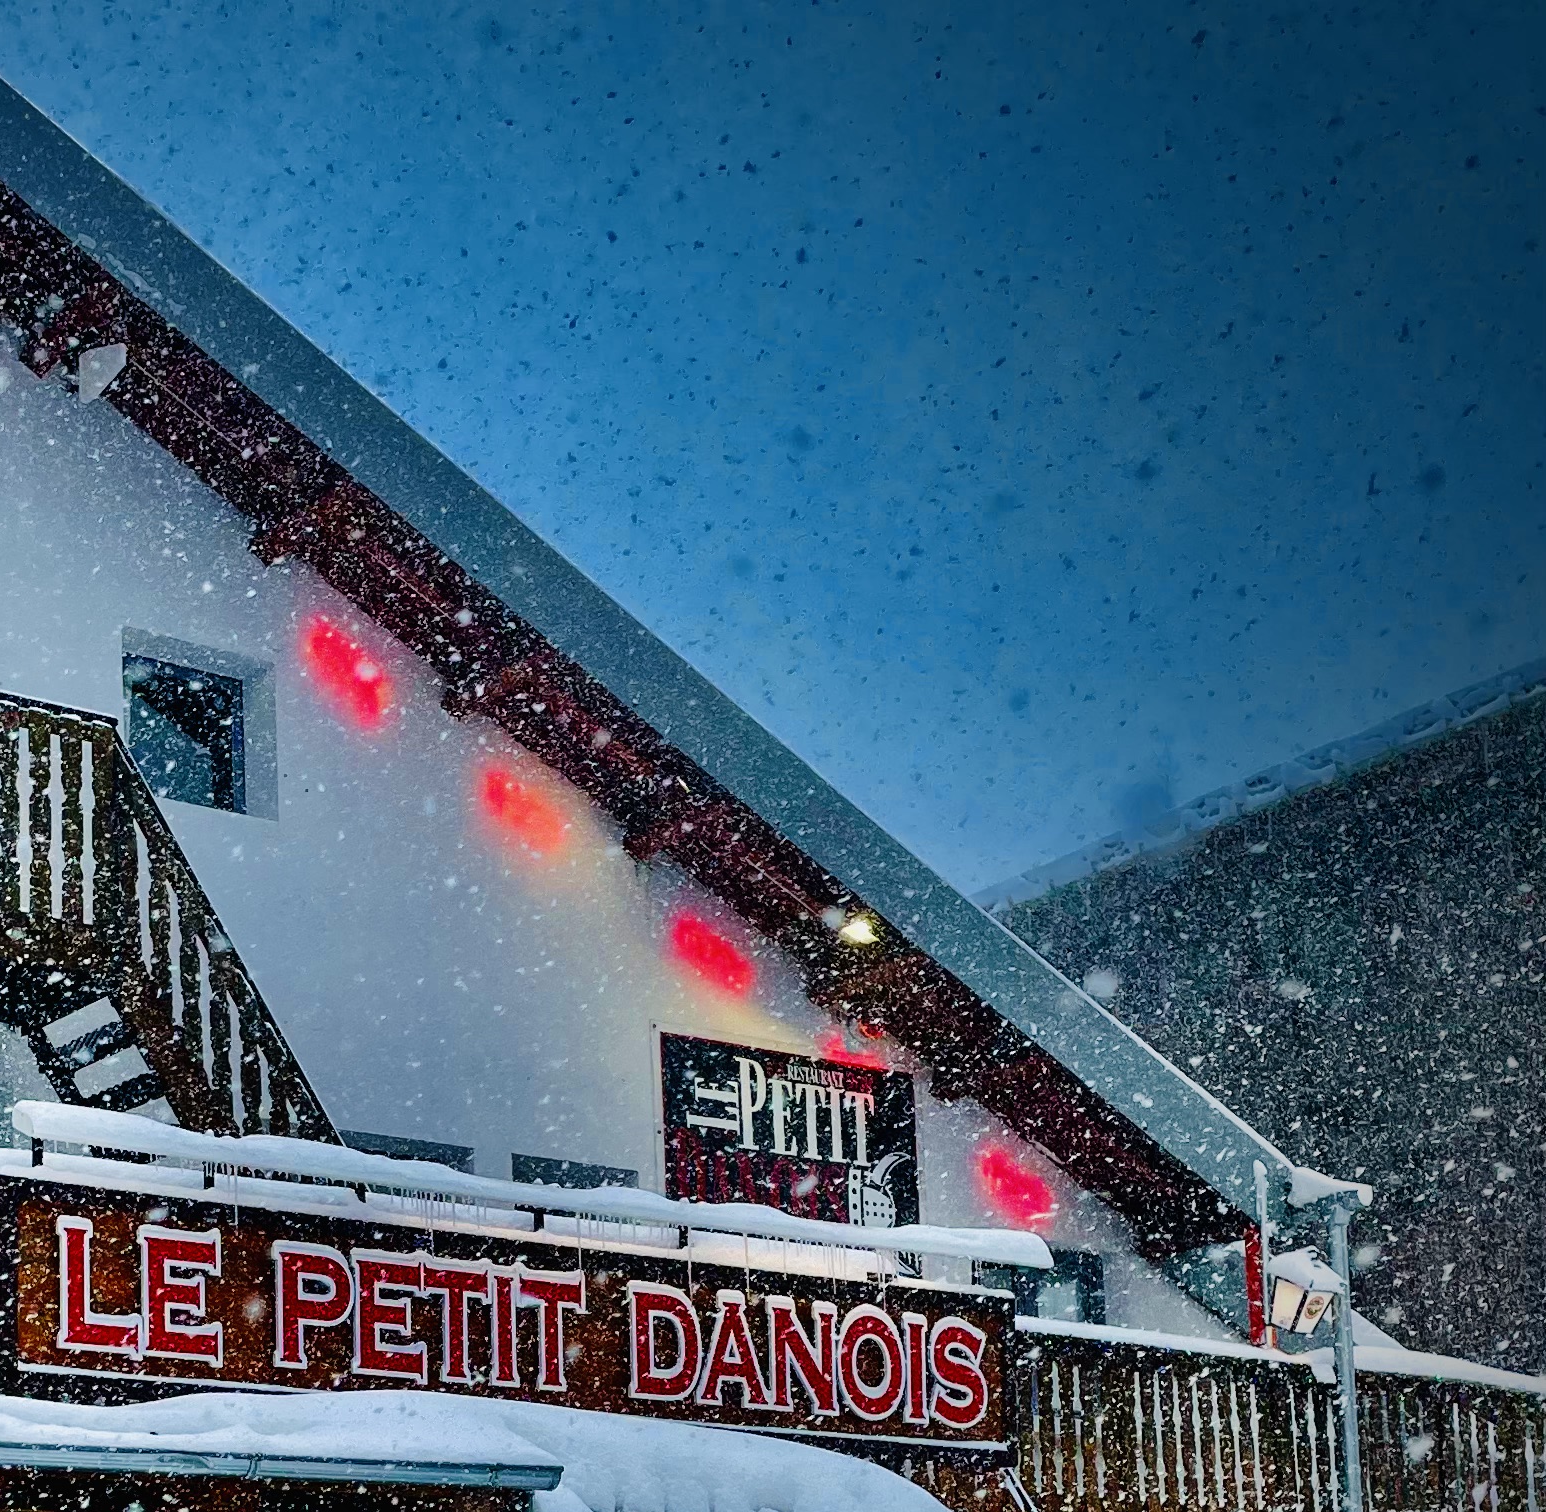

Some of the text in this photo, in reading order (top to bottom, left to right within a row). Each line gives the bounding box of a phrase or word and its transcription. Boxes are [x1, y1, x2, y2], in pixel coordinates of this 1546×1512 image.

[734, 1056, 875, 1168] PETIT
[786, 1062, 844, 1091] RESTAURANT
[56, 1216, 989, 1430] LE PETIT DANOIS
